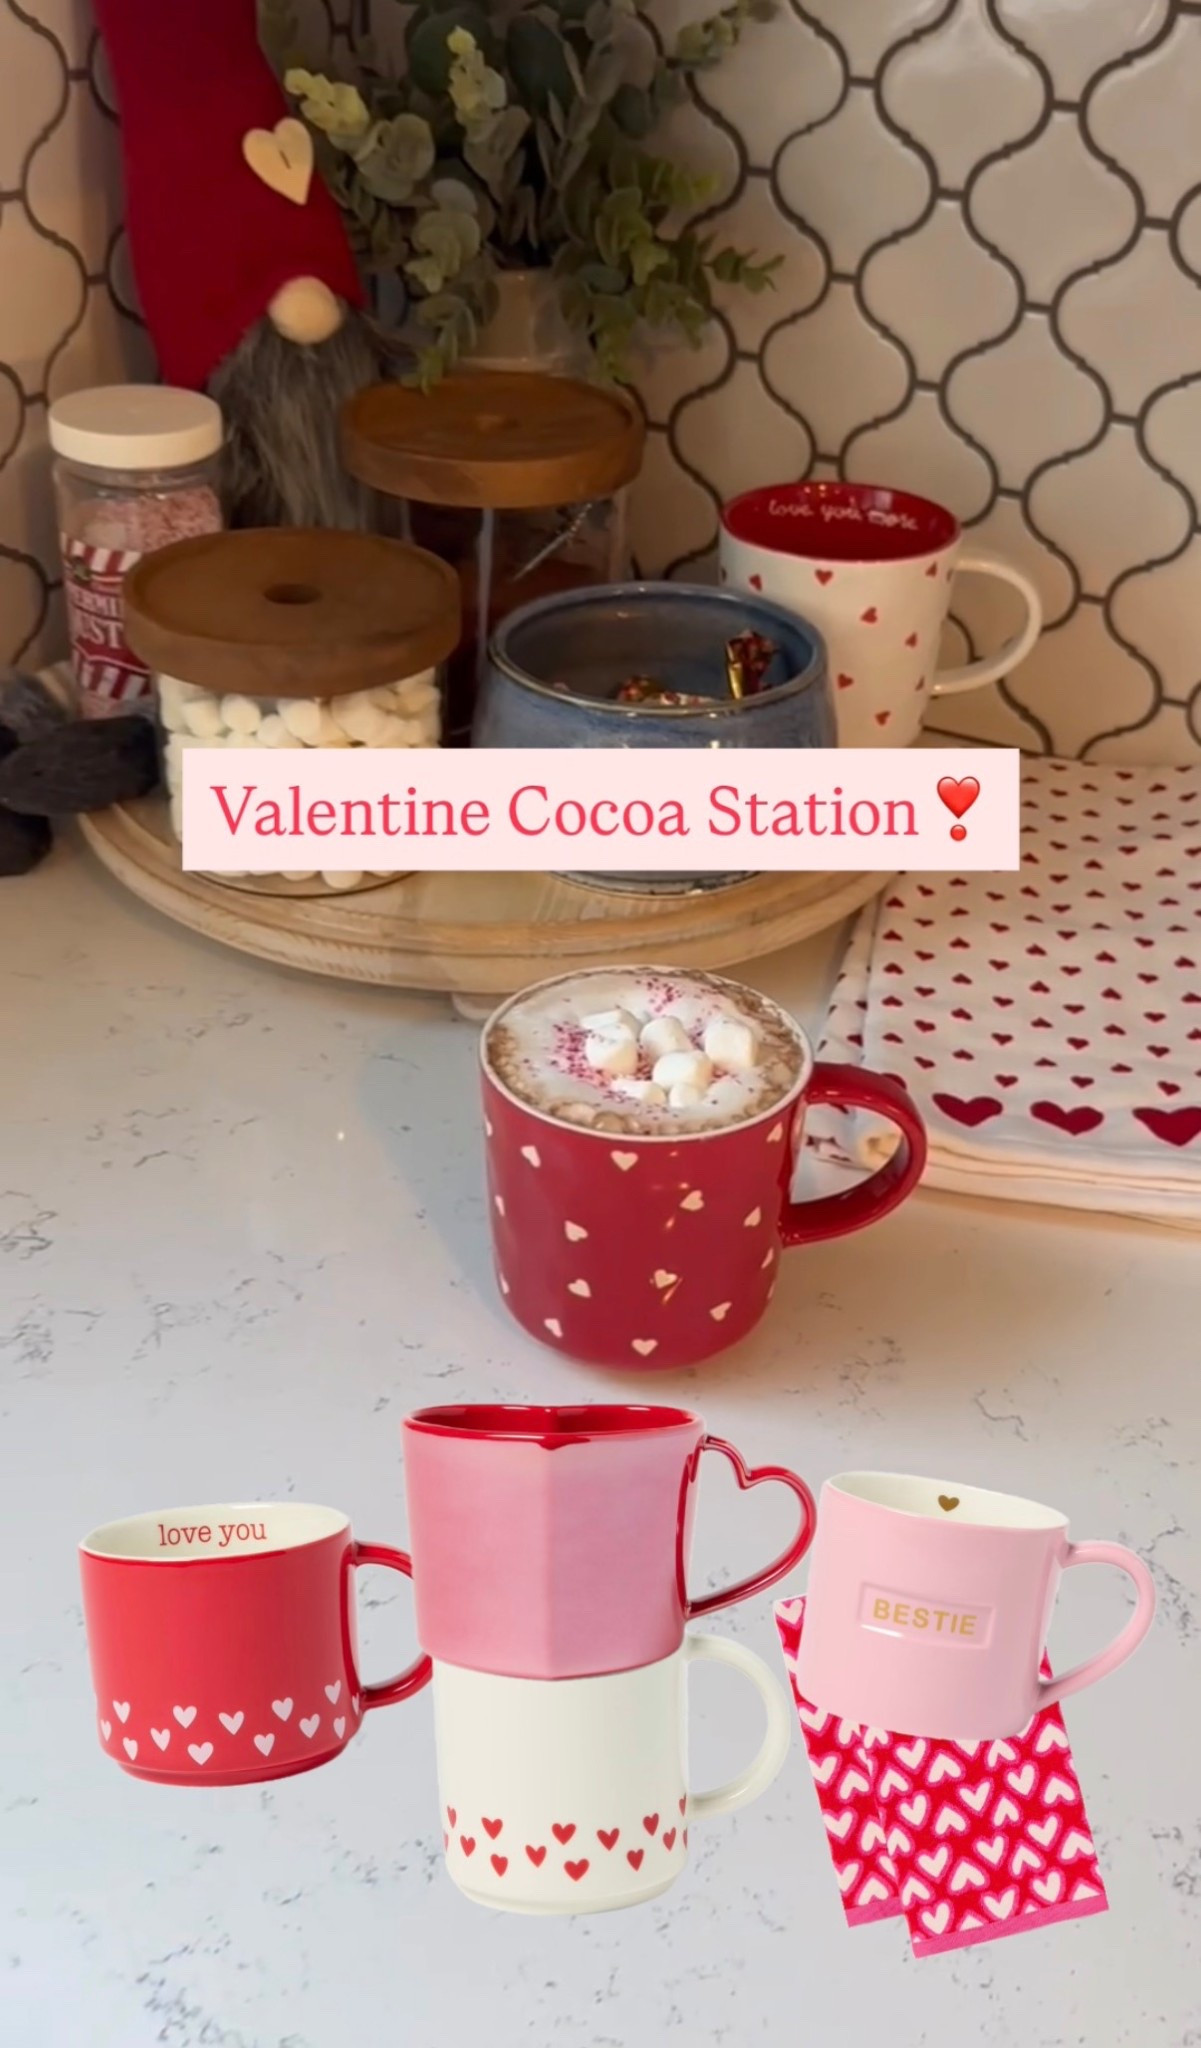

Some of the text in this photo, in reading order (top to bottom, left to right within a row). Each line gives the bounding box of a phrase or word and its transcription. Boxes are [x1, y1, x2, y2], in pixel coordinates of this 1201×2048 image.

[768, 499, 814, 517] love
[820, 503, 863, 523] you
[158, 1523, 267, 1547] love you
[873, 1598, 977, 1635] BESTIE
